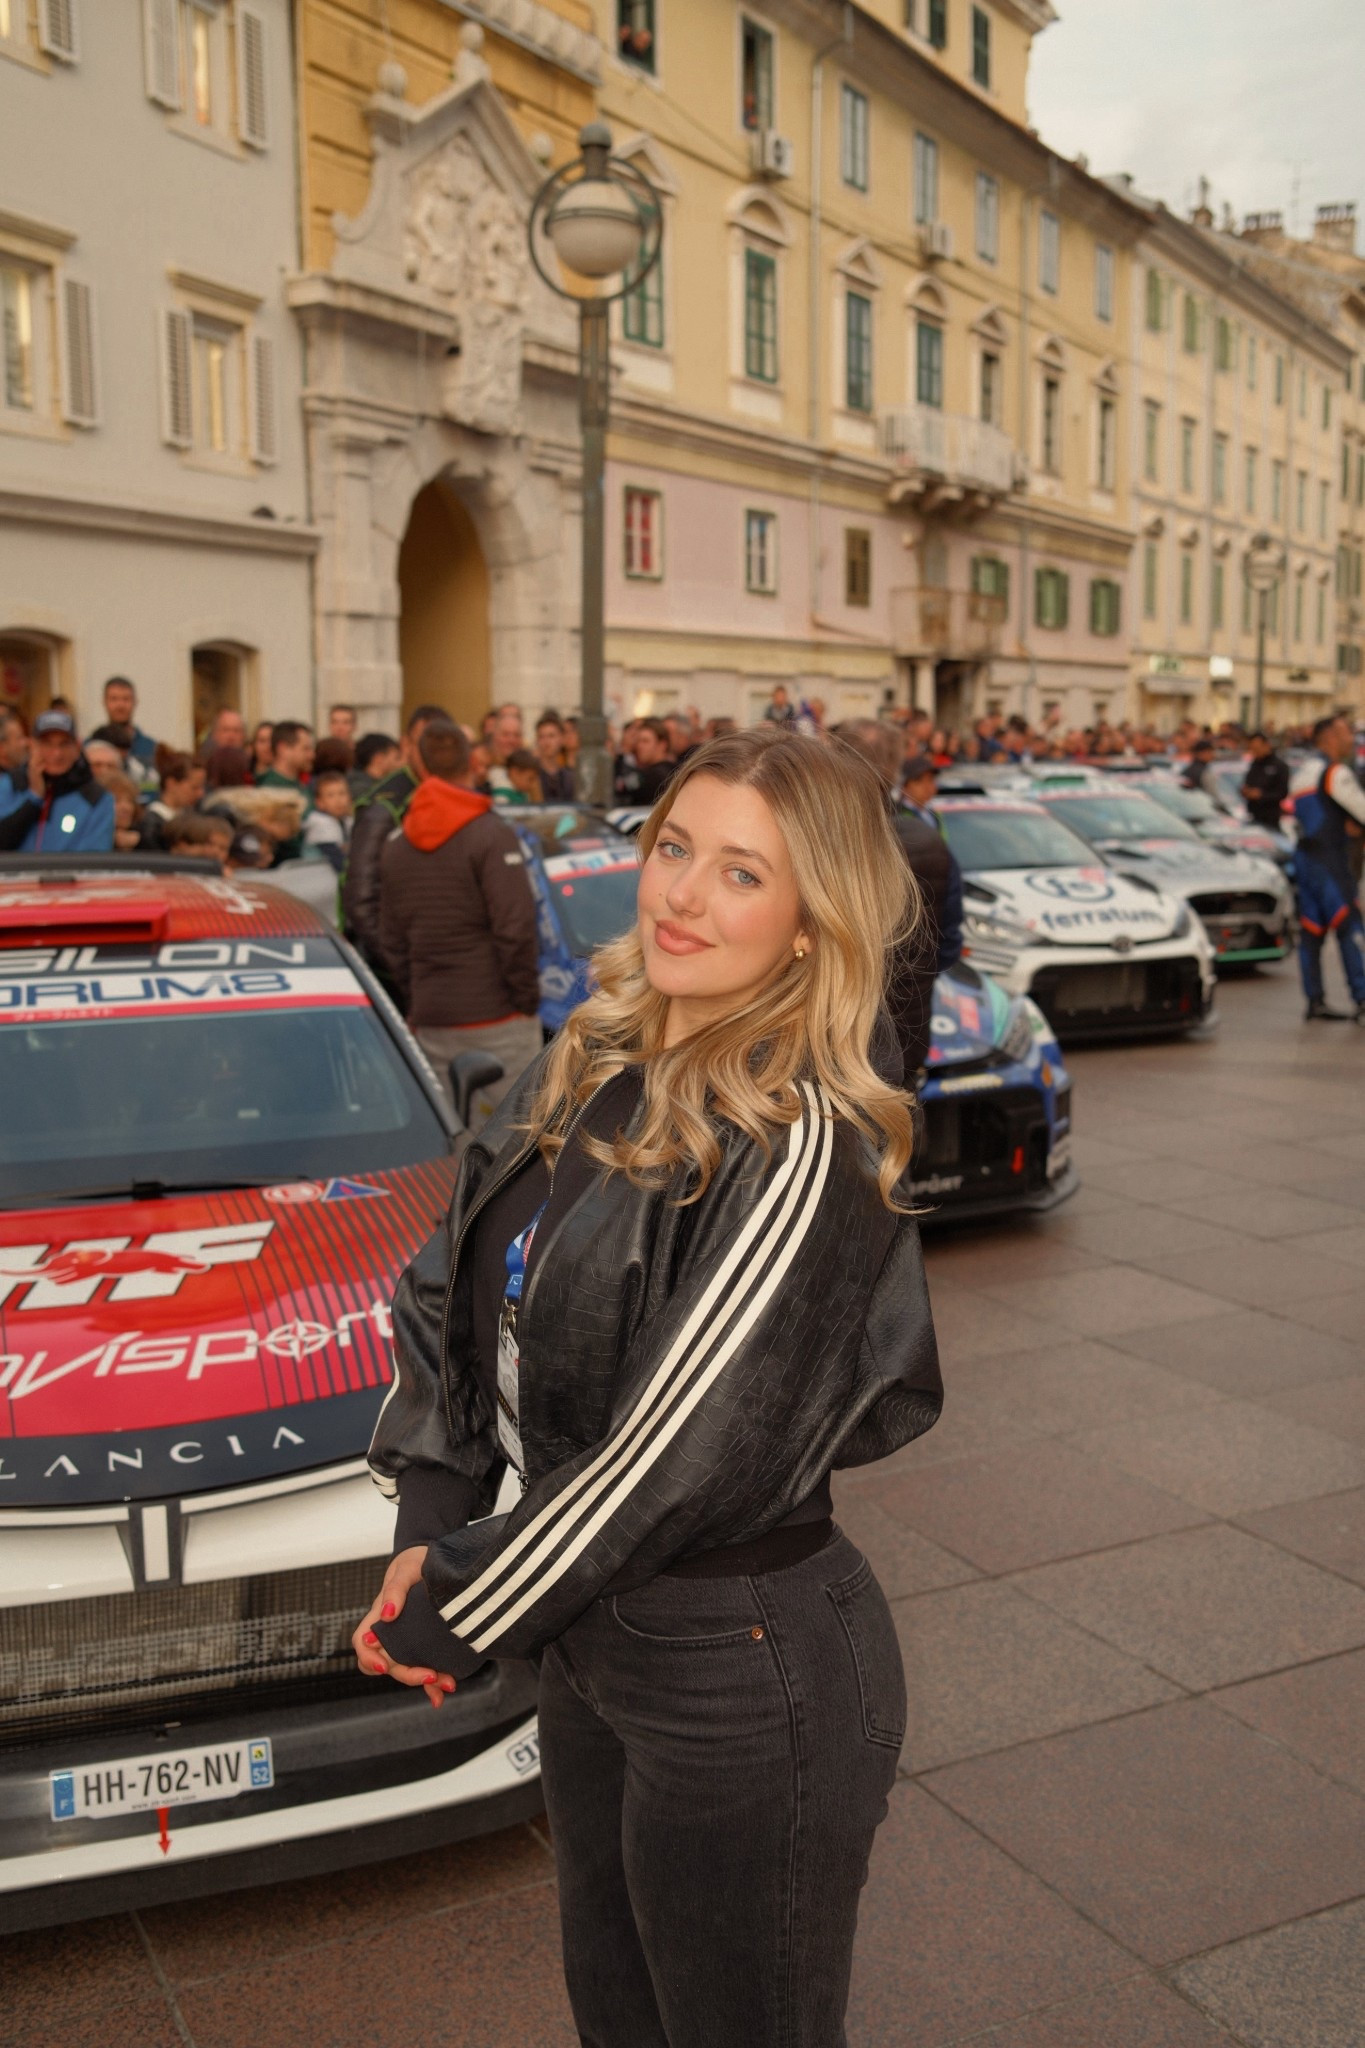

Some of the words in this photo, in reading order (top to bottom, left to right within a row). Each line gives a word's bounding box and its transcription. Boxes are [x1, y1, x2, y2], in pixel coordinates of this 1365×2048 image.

[84, 1752, 241, 1806] HH-762-NV
[253, 1766, 270, 1783] 52
[60, 1800, 69, 1811] F
